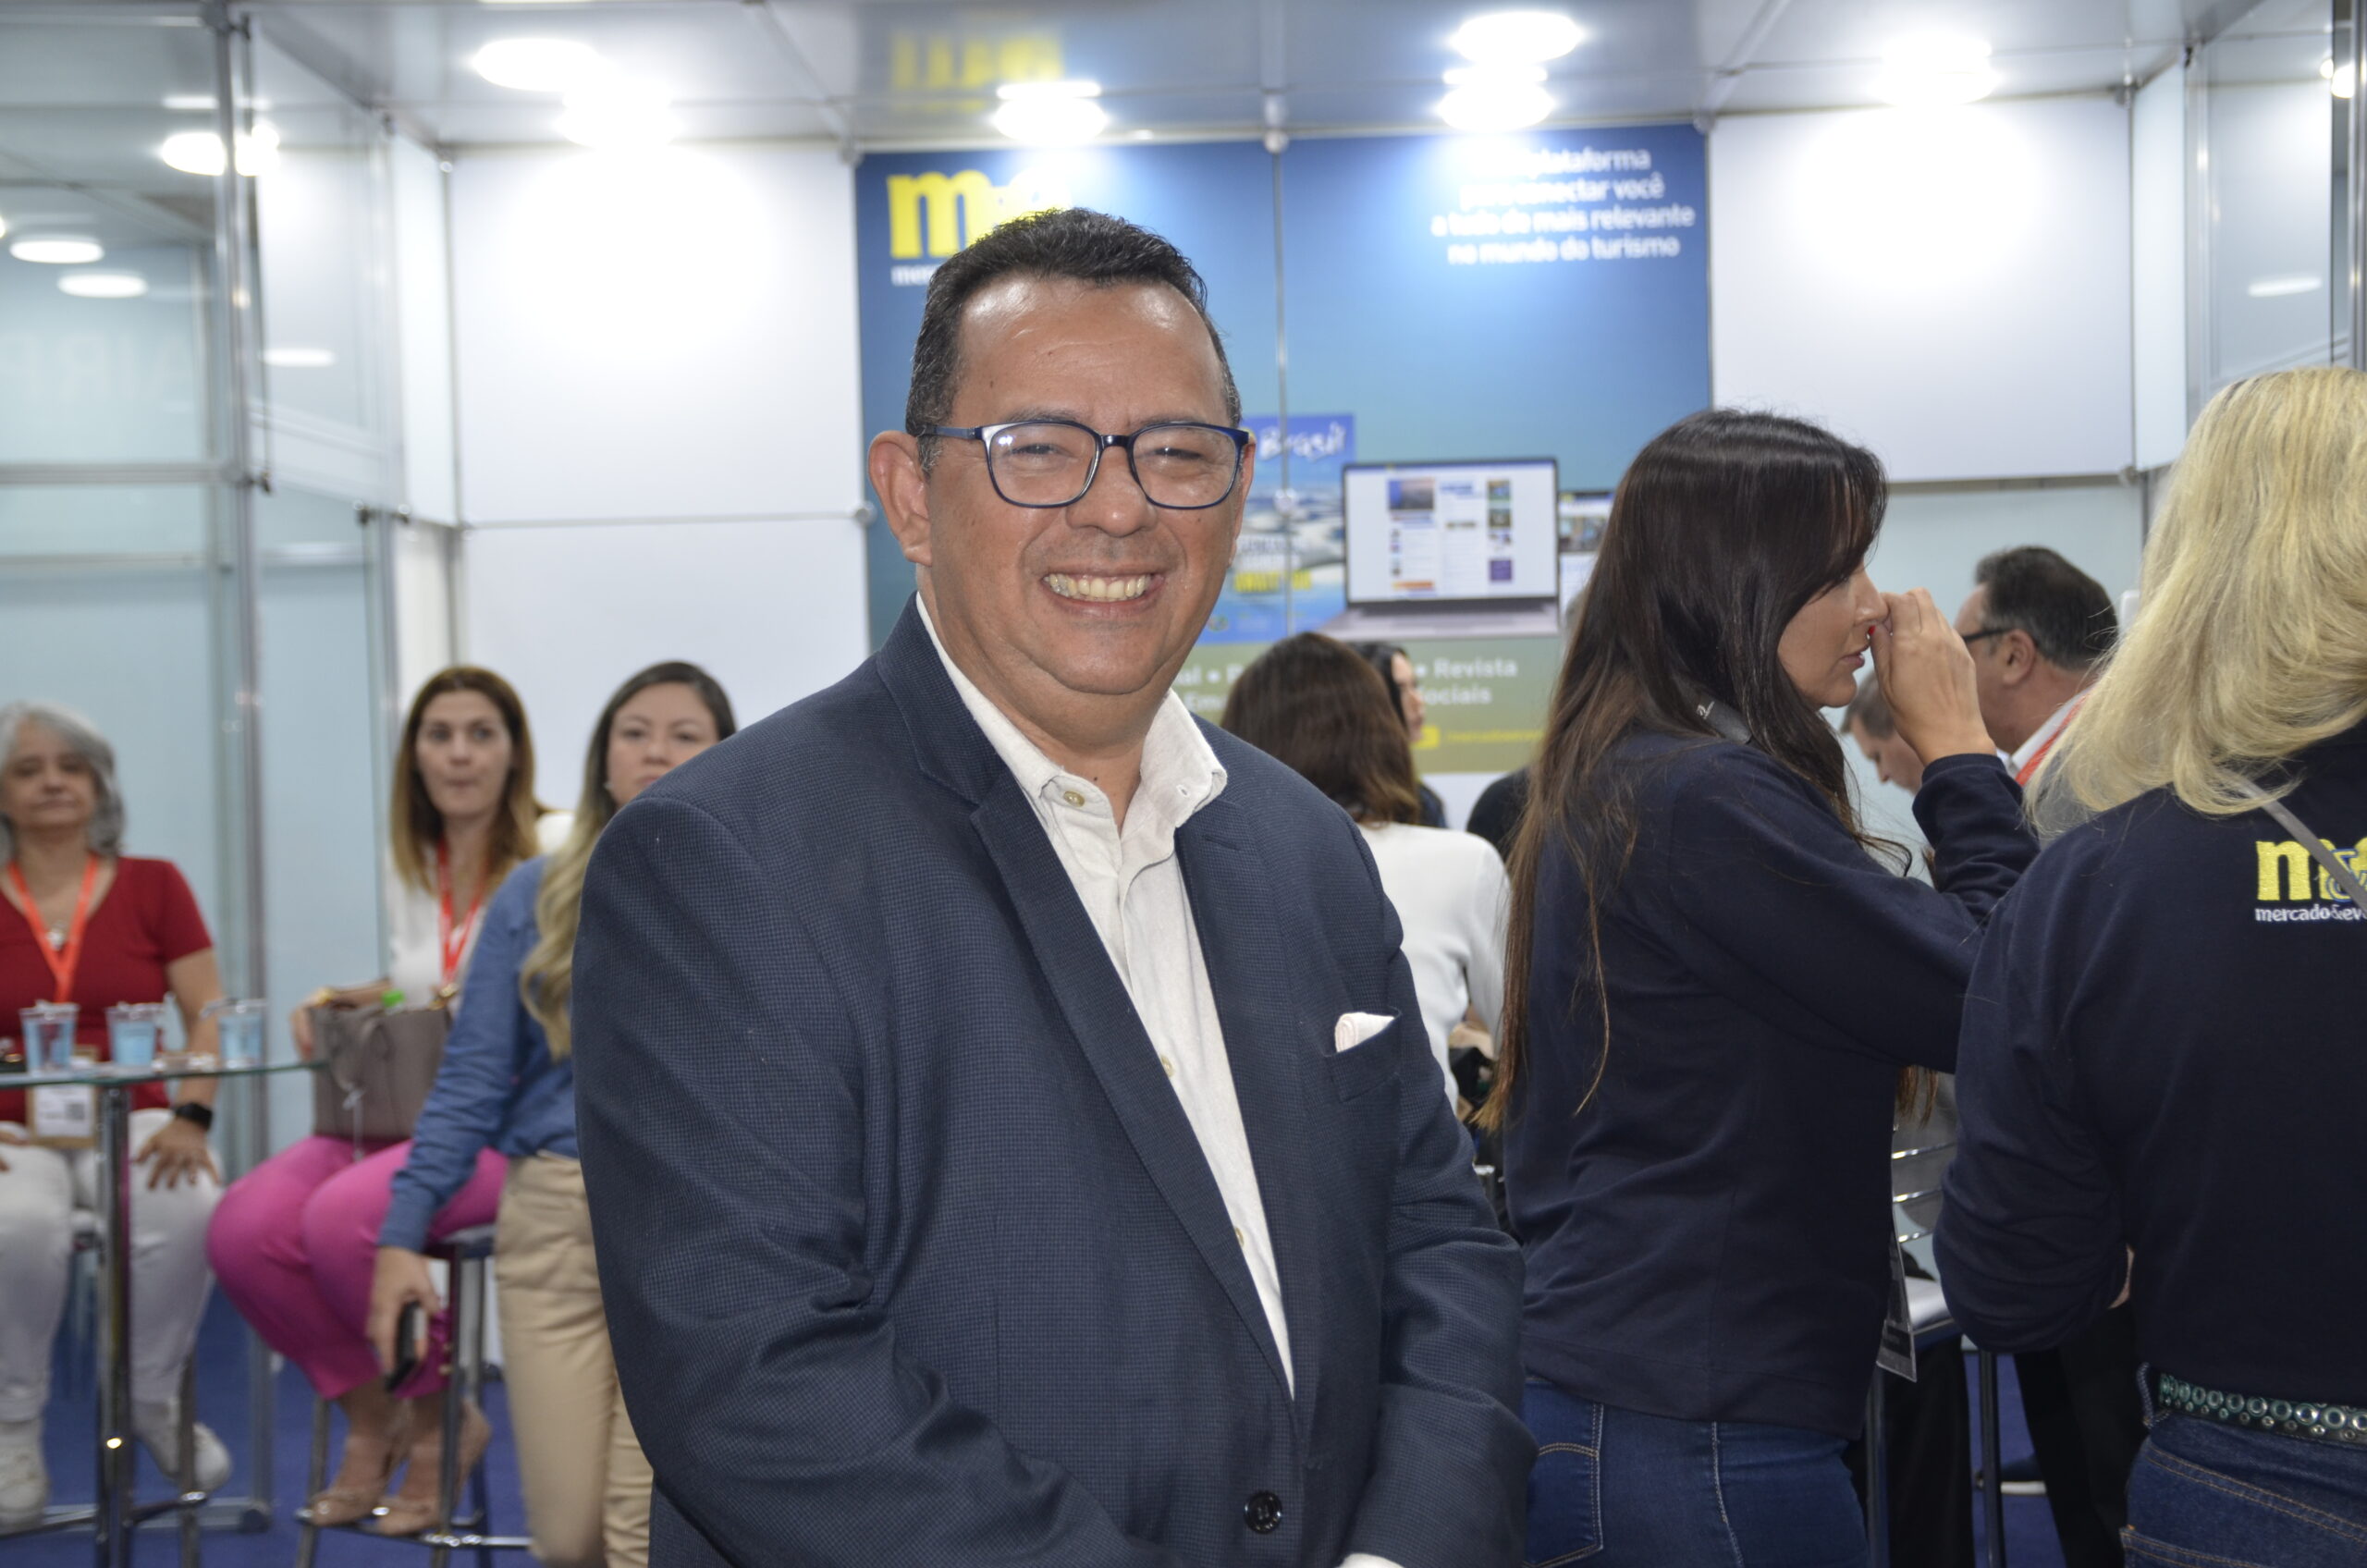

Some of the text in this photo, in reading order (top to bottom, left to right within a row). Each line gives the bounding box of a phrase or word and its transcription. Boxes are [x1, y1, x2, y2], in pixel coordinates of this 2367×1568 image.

[1614, 172, 1664, 200] você
[1532, 207, 1588, 233] mais
[1590, 203, 1695, 230] relevante
[1478, 237, 1558, 263] mundo
[1560, 236, 1589, 261] do
[1591, 233, 1680, 259] turismo
[1434, 657, 1517, 678] Revista
